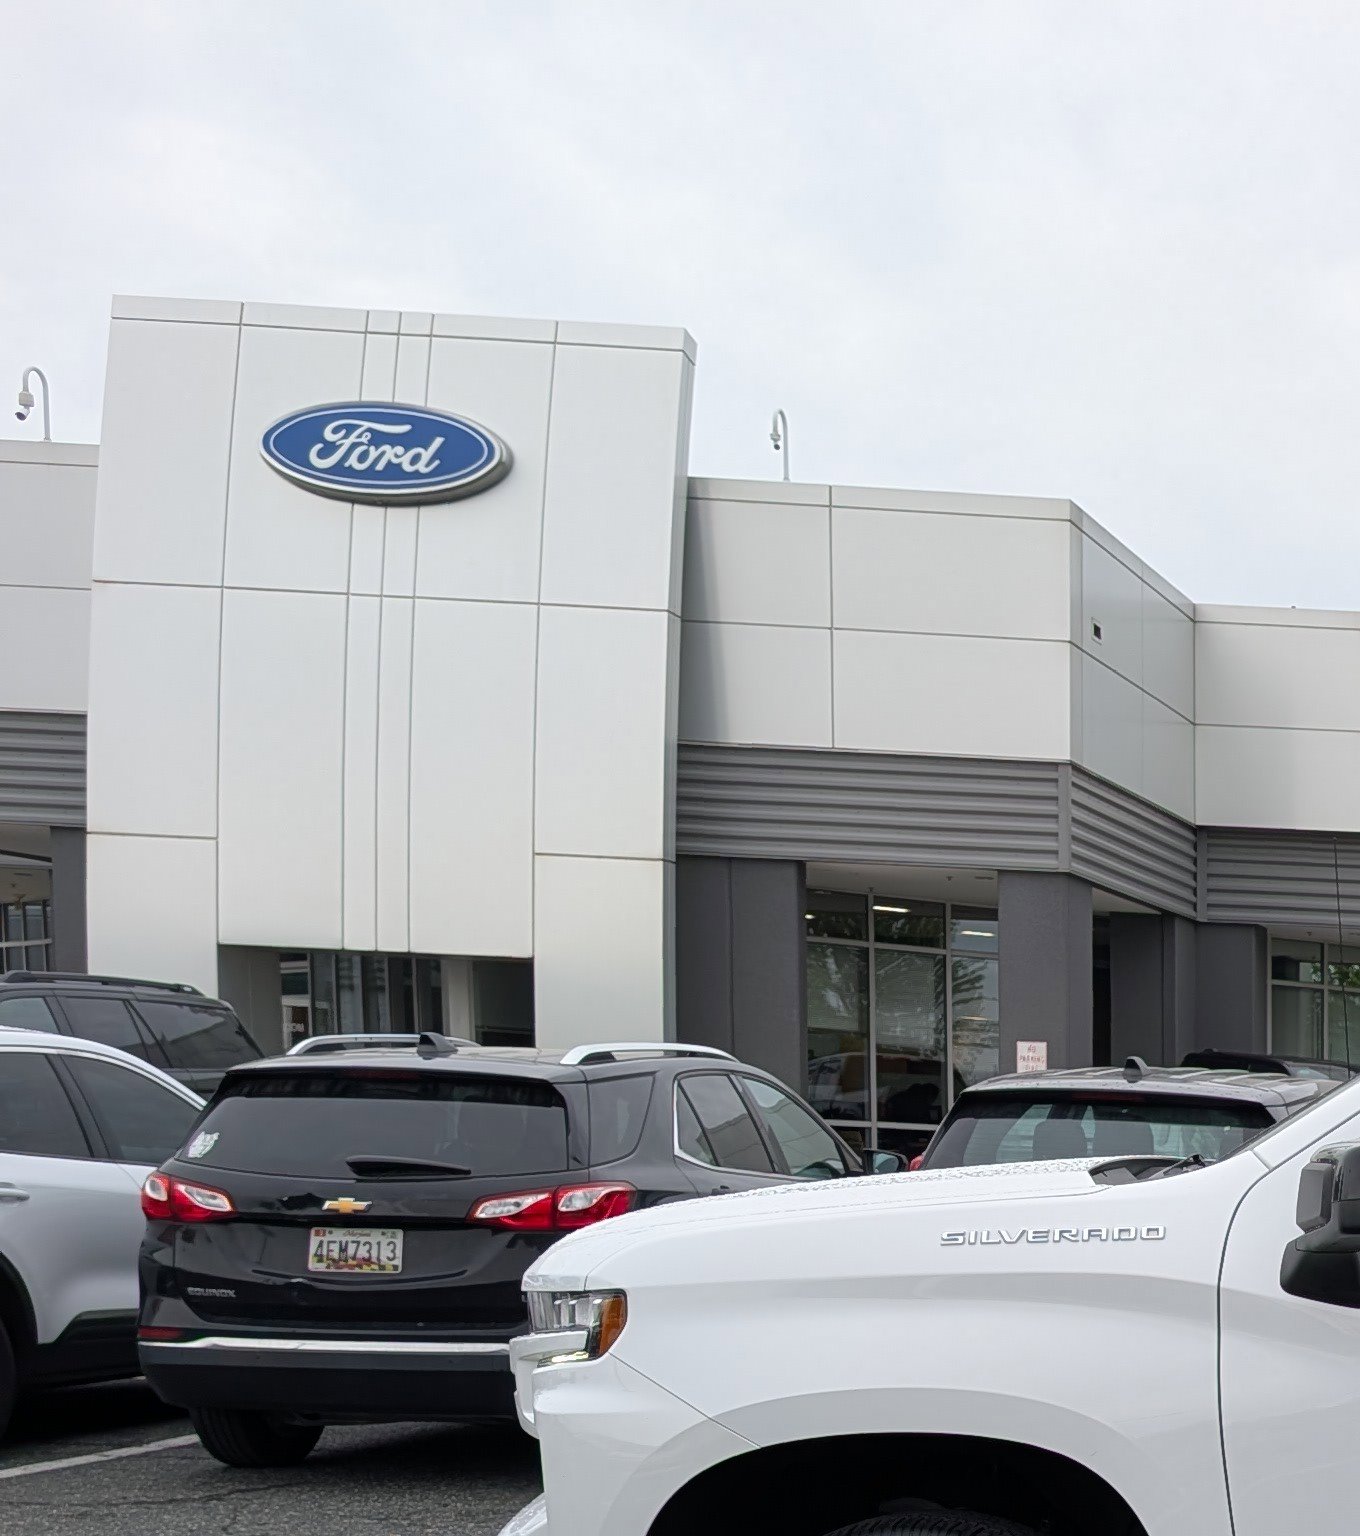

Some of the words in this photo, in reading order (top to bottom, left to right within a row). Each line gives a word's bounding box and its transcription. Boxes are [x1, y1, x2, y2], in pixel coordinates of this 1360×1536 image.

[309, 419, 446, 474] Ford
[940, 1225, 1167, 1246] SILVERADO
[314, 1239, 398, 1263] 4EM7313
